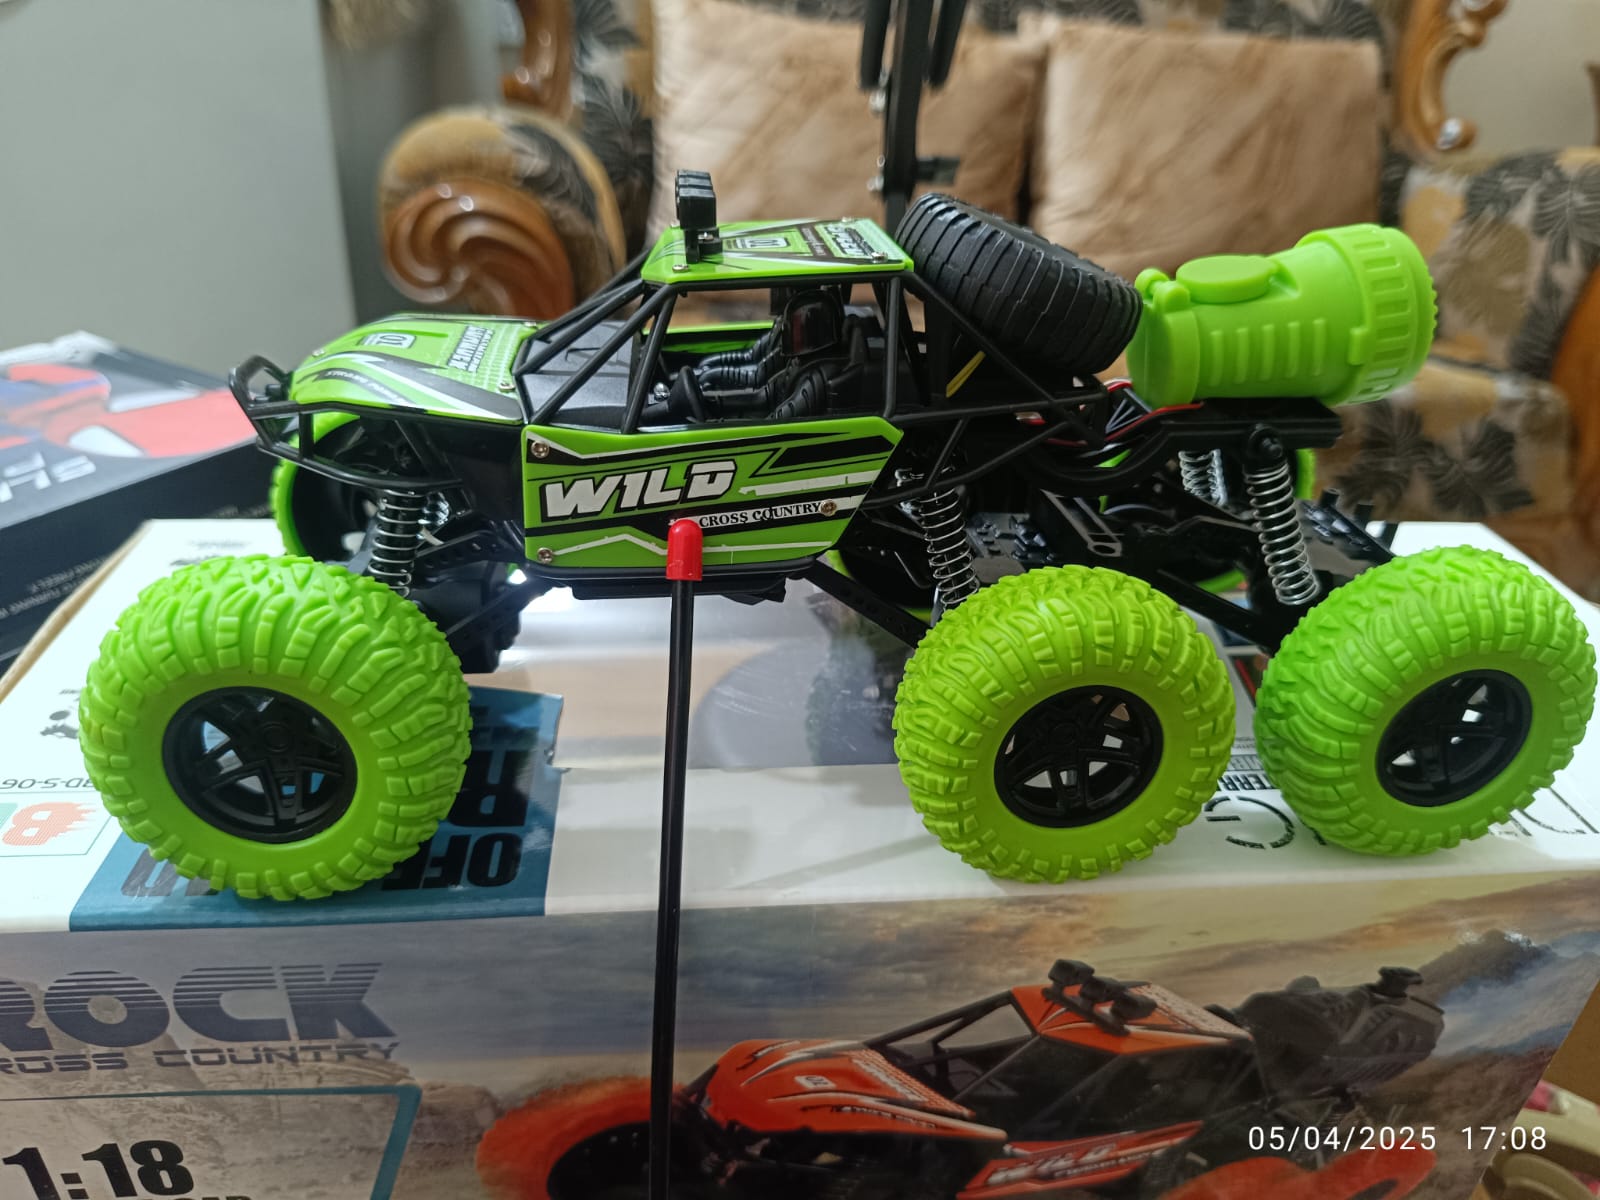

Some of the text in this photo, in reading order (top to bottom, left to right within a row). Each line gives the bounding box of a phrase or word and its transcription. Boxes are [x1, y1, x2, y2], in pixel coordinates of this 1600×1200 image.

[699, 501, 822, 528] CROSS COUNTRY
[153, 1041, 399, 1068] COUNTRY
[3, 1139, 194, 1200] 1:18
